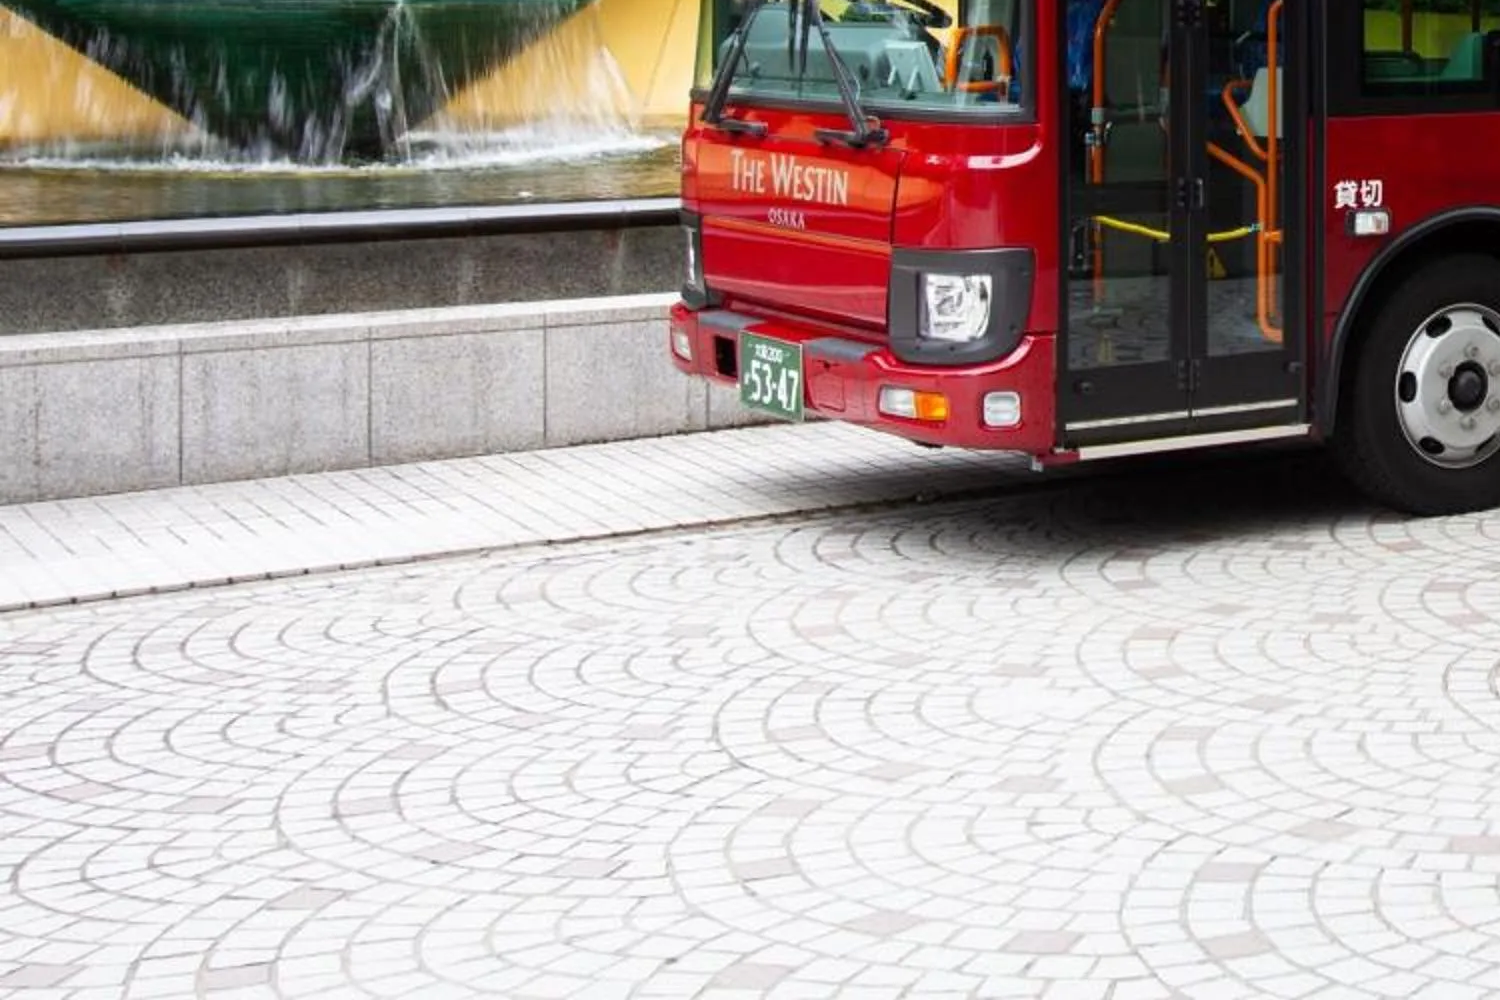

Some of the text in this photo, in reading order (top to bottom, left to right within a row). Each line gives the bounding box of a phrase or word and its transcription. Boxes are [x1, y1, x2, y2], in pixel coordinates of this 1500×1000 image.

[731, 149, 849, 206] THE WESTIN
[1333, 179, 1383, 208] 貸切
[768, 207, 805, 231] OSAKA
